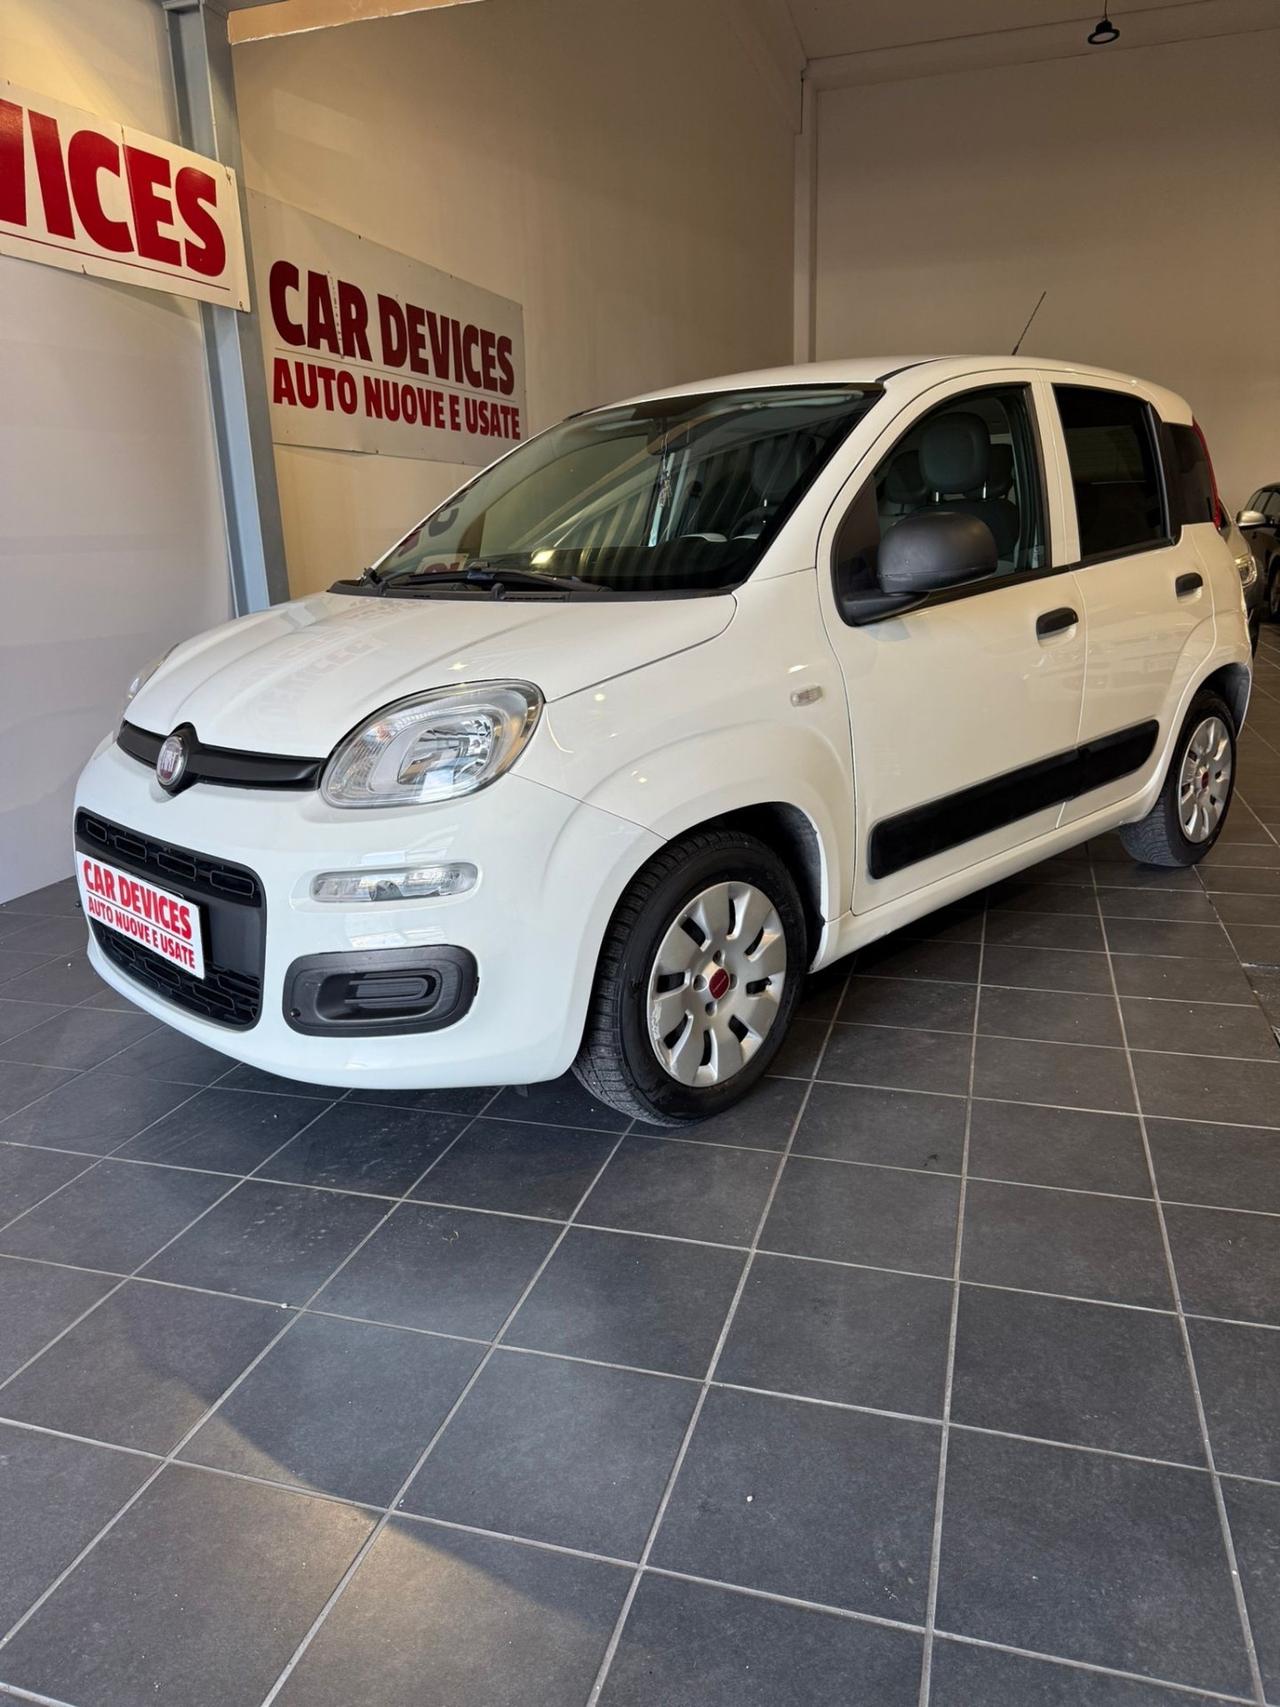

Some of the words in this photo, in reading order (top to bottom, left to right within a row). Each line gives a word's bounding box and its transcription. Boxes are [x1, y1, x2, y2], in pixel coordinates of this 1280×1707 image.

[269, 260, 373, 362] CAR
[377, 293, 515, 396] DEVICES
[273, 357, 358, 415] AUTO
[363, 375, 445, 429] NUOVE
[448, 394, 461, 432] E
[464, 397, 521, 441] USATE
[83, 860, 116, 902] CAR
[117, 875, 192, 940] DEVICES
[88, 896, 114, 924] AUTO
[115, 910, 151, 944] NUOVE
[152, 929, 159, 948] E
[160, 933, 196, 970] USATE
